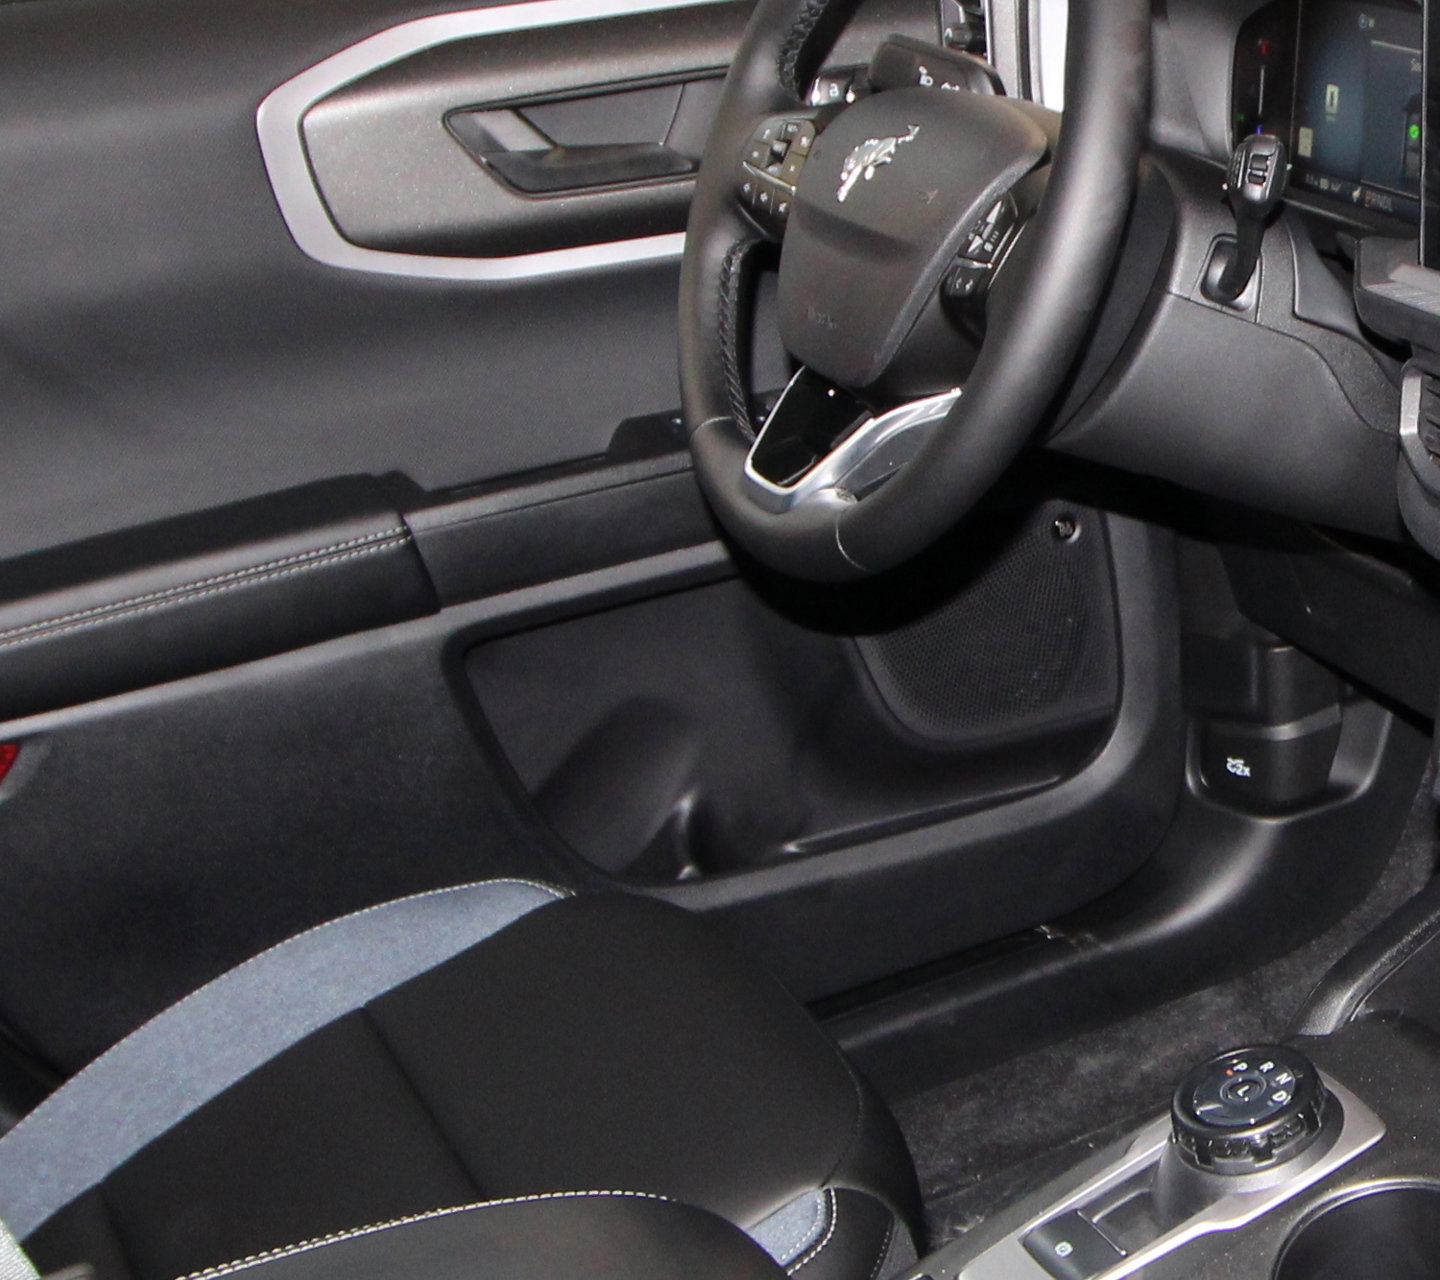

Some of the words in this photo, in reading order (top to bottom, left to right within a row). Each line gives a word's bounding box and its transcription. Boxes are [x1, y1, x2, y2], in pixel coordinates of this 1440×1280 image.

[1233, 1062, 1248, 1072] P
[1260, 1061, 1275, 1073] R
[1275, 1072, 1292, 1085] N
[1237, 1085, 1250, 1097] L
[1272, 1090, 1288, 1103] D
